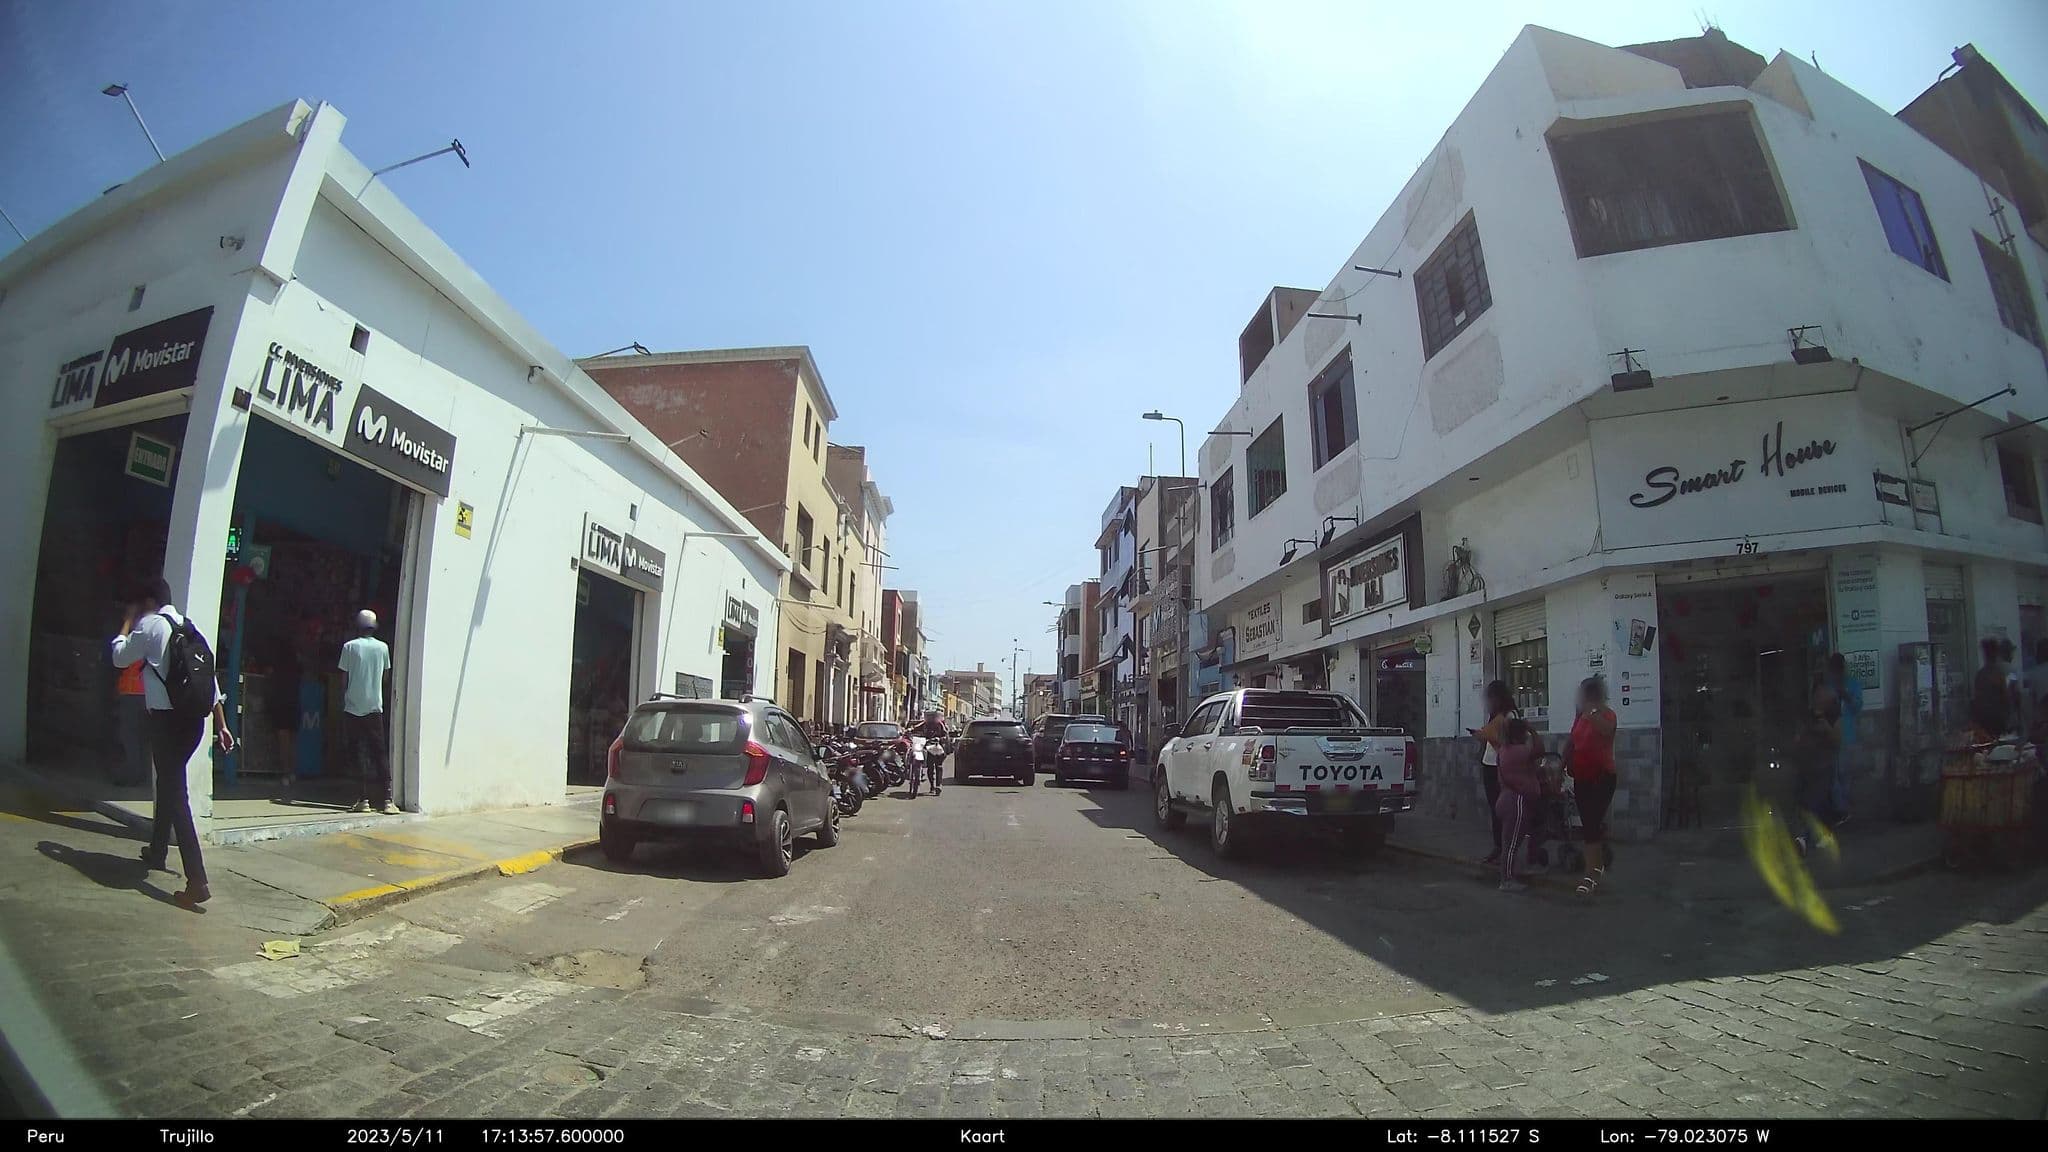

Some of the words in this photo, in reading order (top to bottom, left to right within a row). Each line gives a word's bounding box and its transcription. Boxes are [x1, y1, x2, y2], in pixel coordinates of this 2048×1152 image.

[133, 341, 196, 373] Movistar
[50, 366, 96, 409] LIMA
[258, 355, 337, 434] LIMA
[391, 427, 450, 474] Movistar
[1628, 459, 1747, 509] Smart
[1760, 421, 1838, 478] House
[1790, 486, 1816, 498] MOBILE
[1817, 484, 1847, 496] DEVICES
[588, 531, 620, 569] LIMA
[1736, 542, 1760, 555] 797
[638, 555, 664, 577] Movistar
[1247, 602, 1271, 621] TEXTILES
[1299, 765, 1384, 781] TOYOTA
